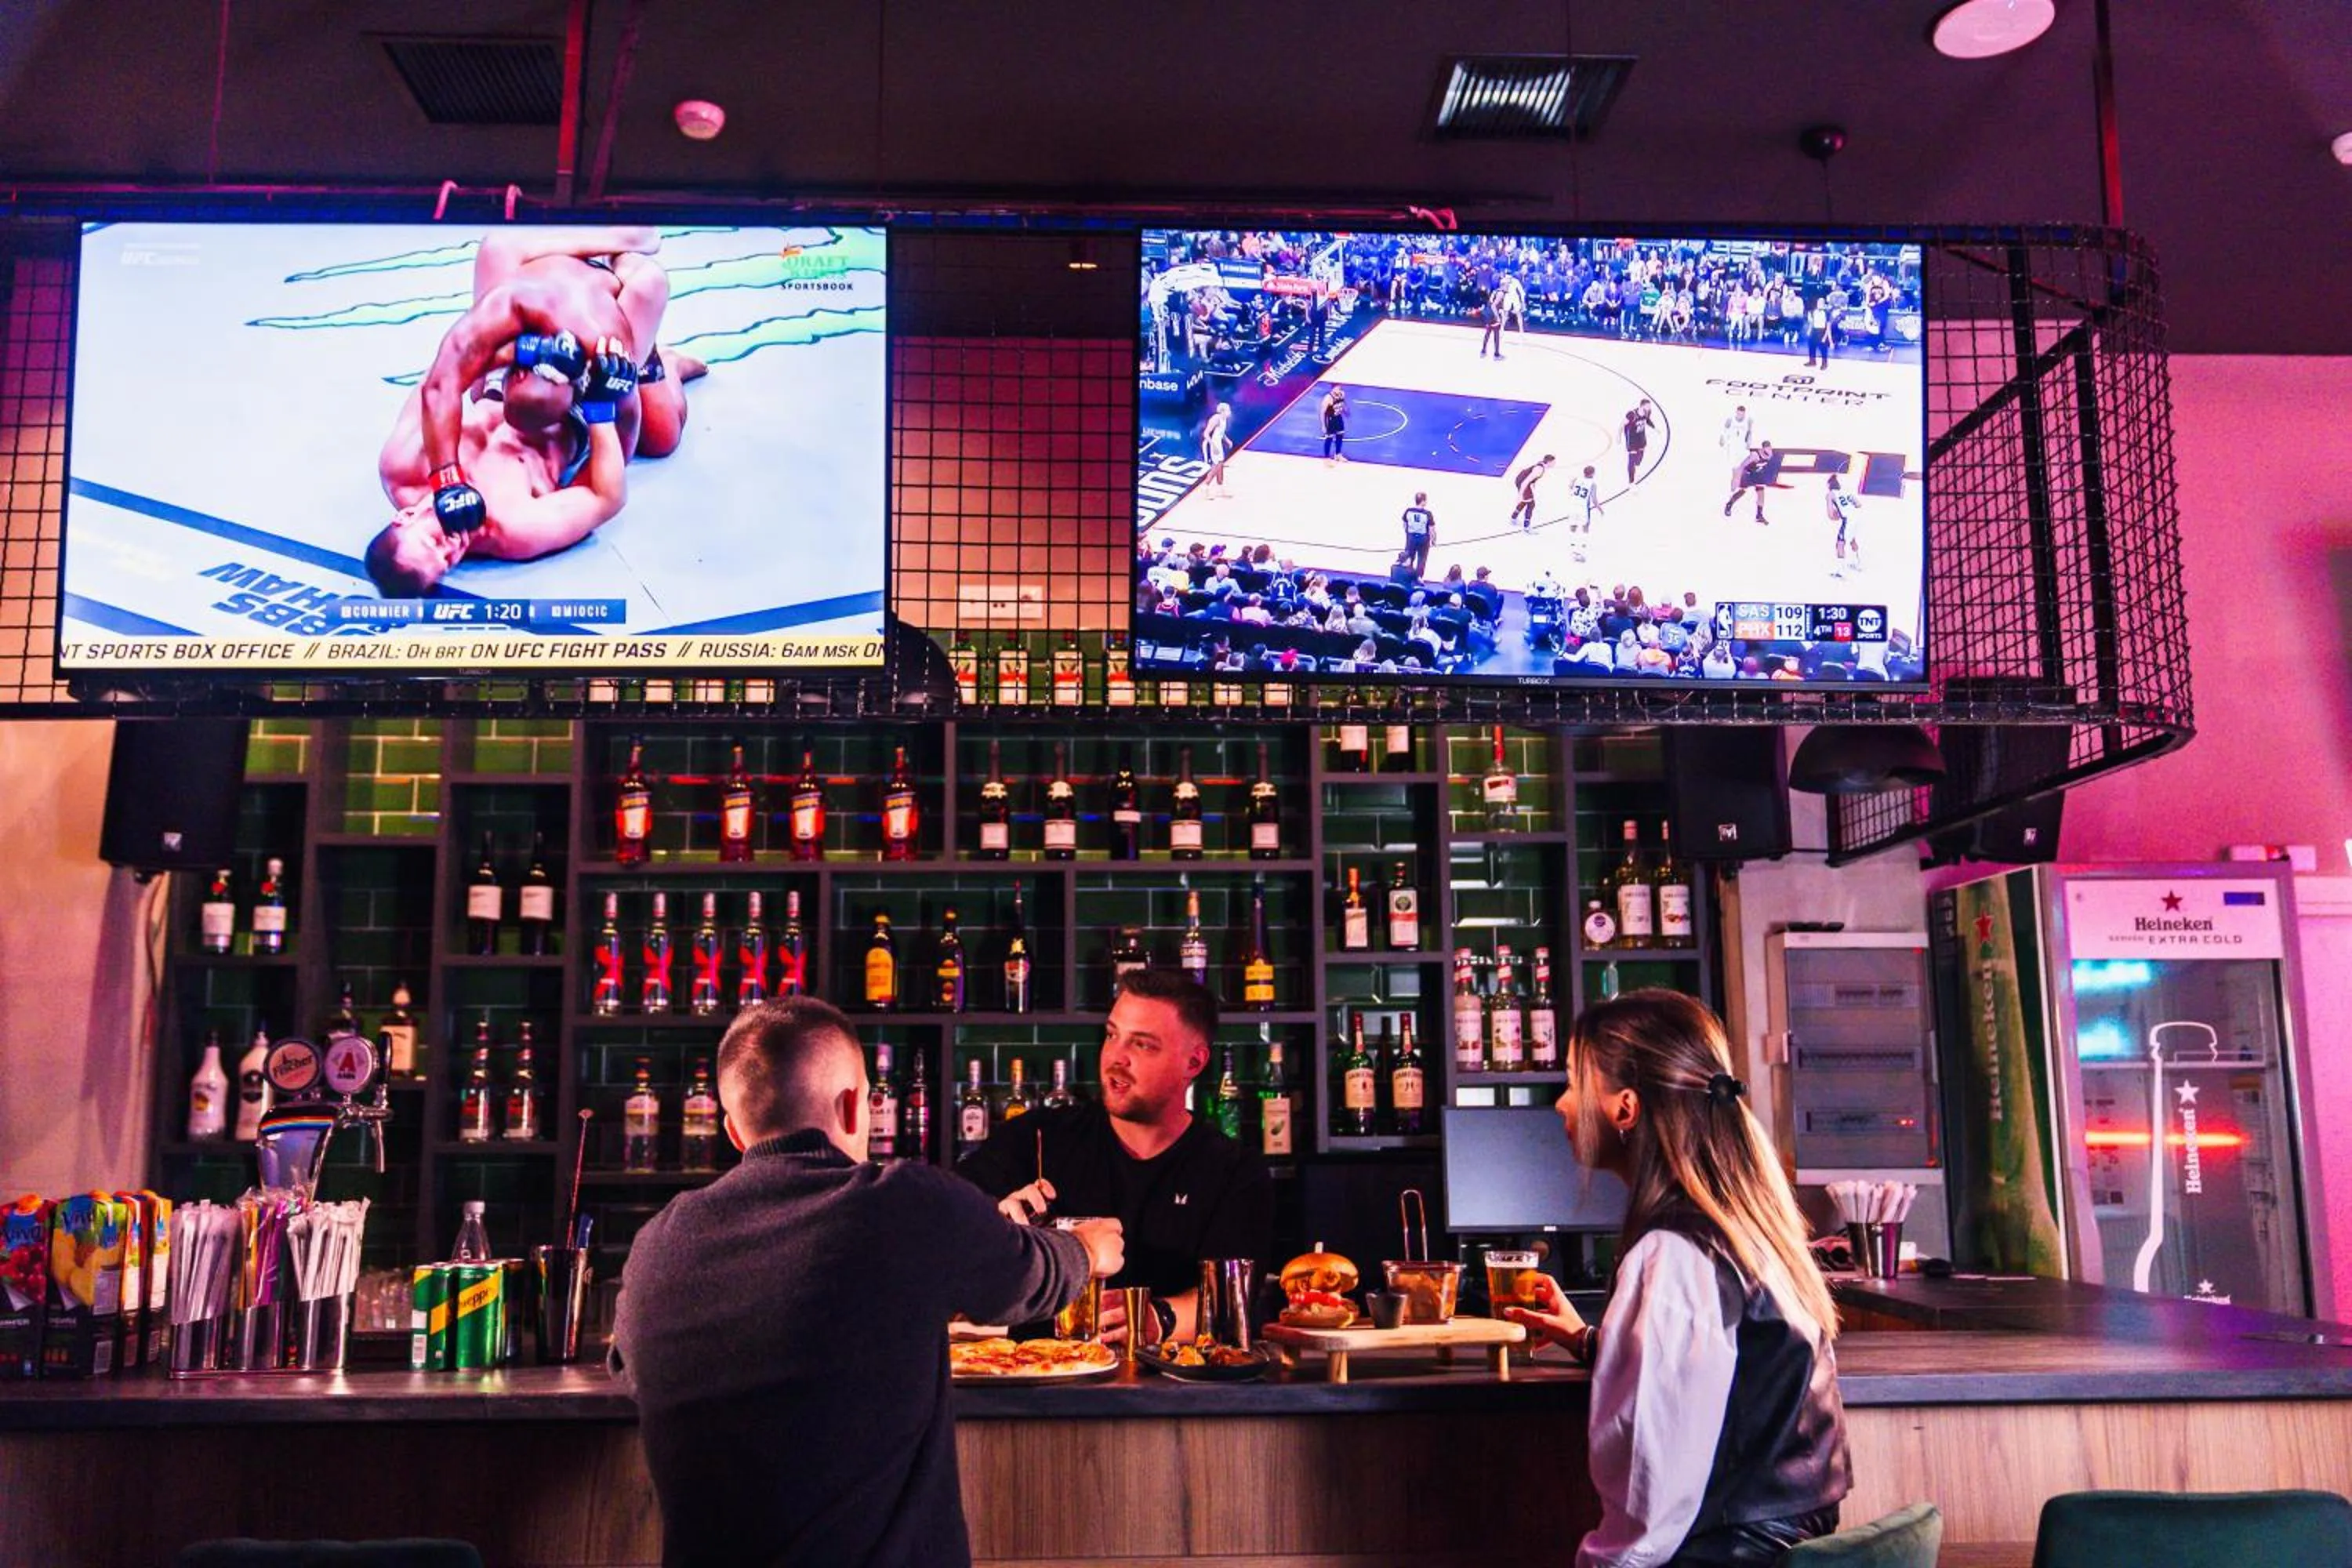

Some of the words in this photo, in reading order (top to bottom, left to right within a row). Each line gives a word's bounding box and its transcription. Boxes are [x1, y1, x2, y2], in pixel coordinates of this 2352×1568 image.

[781, 282, 854, 291] SPORTSBOOK
[606, 376, 633, 393] UFC
[1706, 379, 1891, 400] FOOTPRINT
[1574, 485, 1588, 499] 33
[445, 491, 477, 513] UFC
[198, 562, 375, 614] HAW
[353, 605, 410, 618] CORMIER
[434, 604, 476, 619] UFC
[485, 604, 522, 619] 1:20
[564, 605, 608, 618] MIOCIC
[1736, 604, 1769, 618] SAS
[1776, 606, 1803, 619] 109
[1818, 607, 1847, 620] 1:30
[1859, 617, 1882, 627] TNT
[1735, 622, 1769, 637] PHX
[1777, 624, 1803, 637] 112
[1836, 626, 1851, 637] 13
[87, 644, 168, 659] SPORTS
[173, 644, 216, 659] BOX
[221, 644, 295, 659] OFFICE
[328, 643, 401, 659] BRAZIL:
[470, 644, 499, 659] ON
[504, 643, 545, 659] UFC
[549, 642, 610, 658] FIGHT
[613, 642, 667, 658] PASS
[699, 642, 776, 658] RUSSIA:
[782, 642, 819, 658] 6AM
[822, 644, 859, 658] MSK
[2135, 916, 2214, 931] Heineken
[2149, 935, 2198, 945] EXTRA
[2203, 935, 2243, 945] COLD
[2181, 1108, 2202, 1194] Heineken
